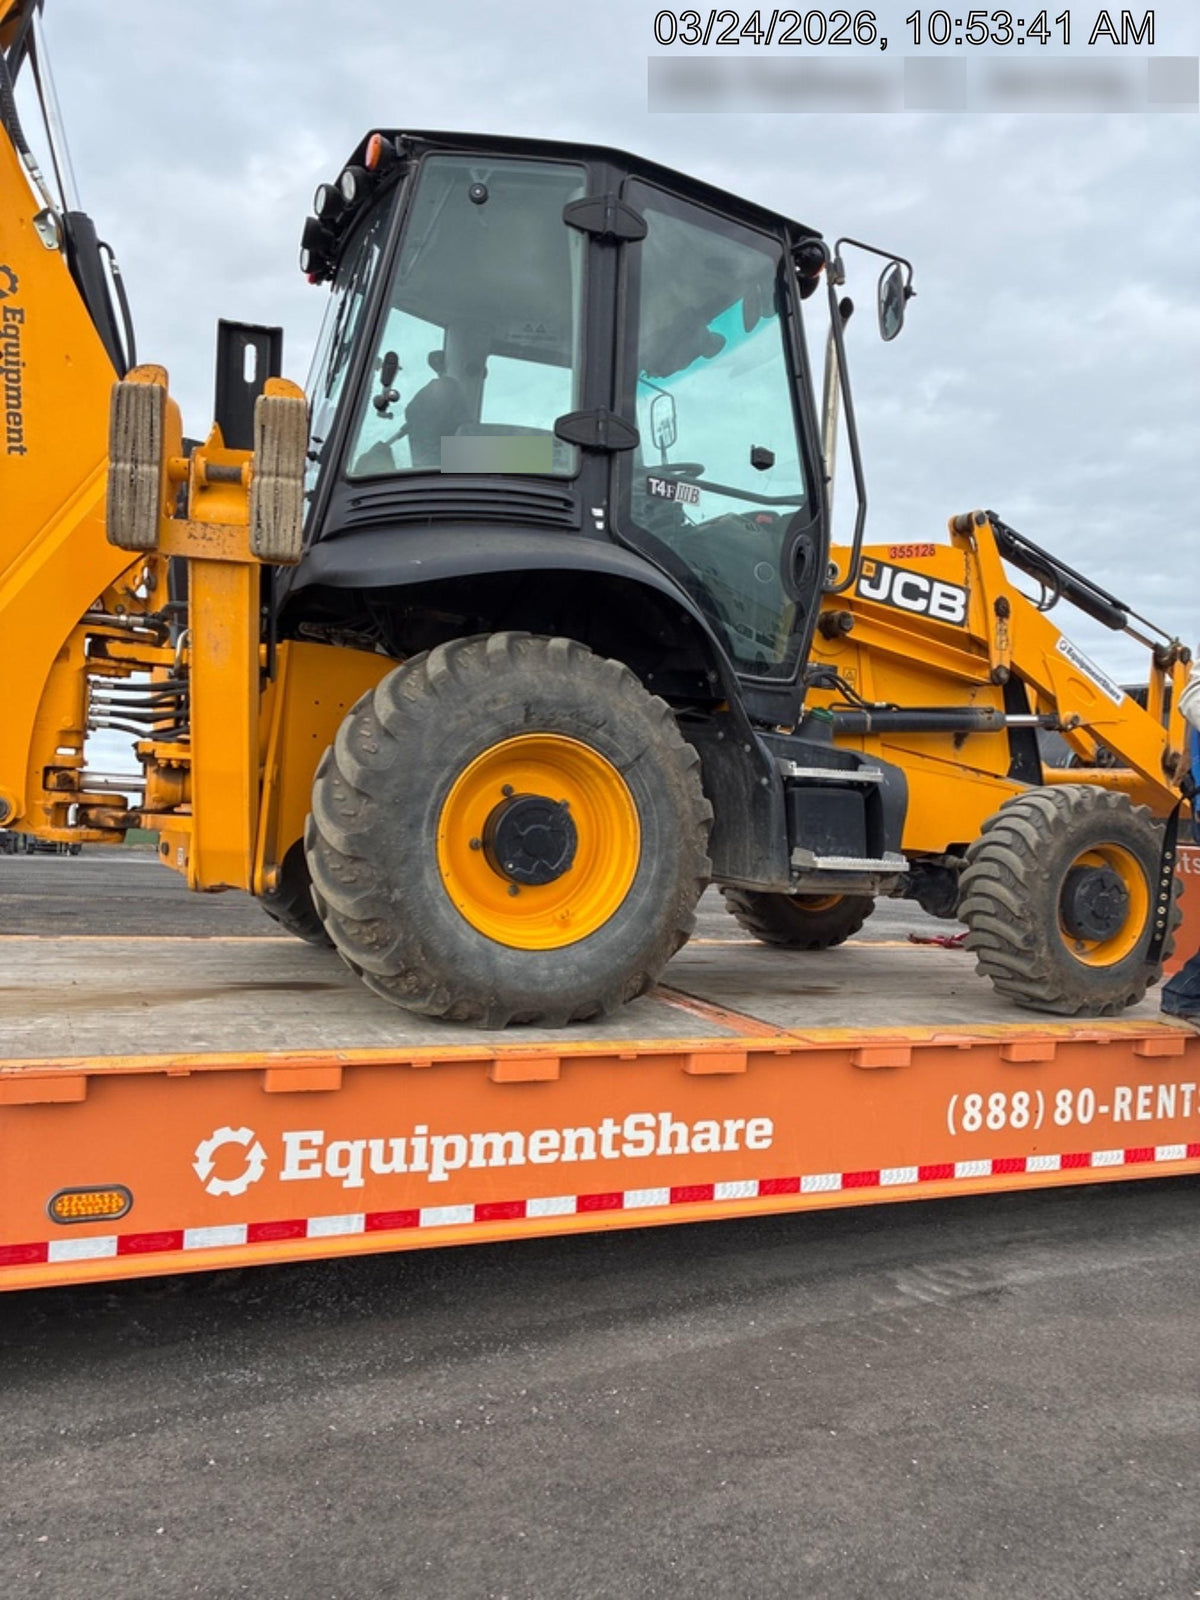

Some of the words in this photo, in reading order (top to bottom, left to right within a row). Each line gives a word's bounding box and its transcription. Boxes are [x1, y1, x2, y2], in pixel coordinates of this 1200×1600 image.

[0, 305, 28, 456] Equipment
[858, 566, 966, 623] JCB
[946, 1090, 1045, 1136] (888)
[1053, 1083, 1200, 1126] 80-RENT
[279, 1112, 775, 1188] EquipmentShare
